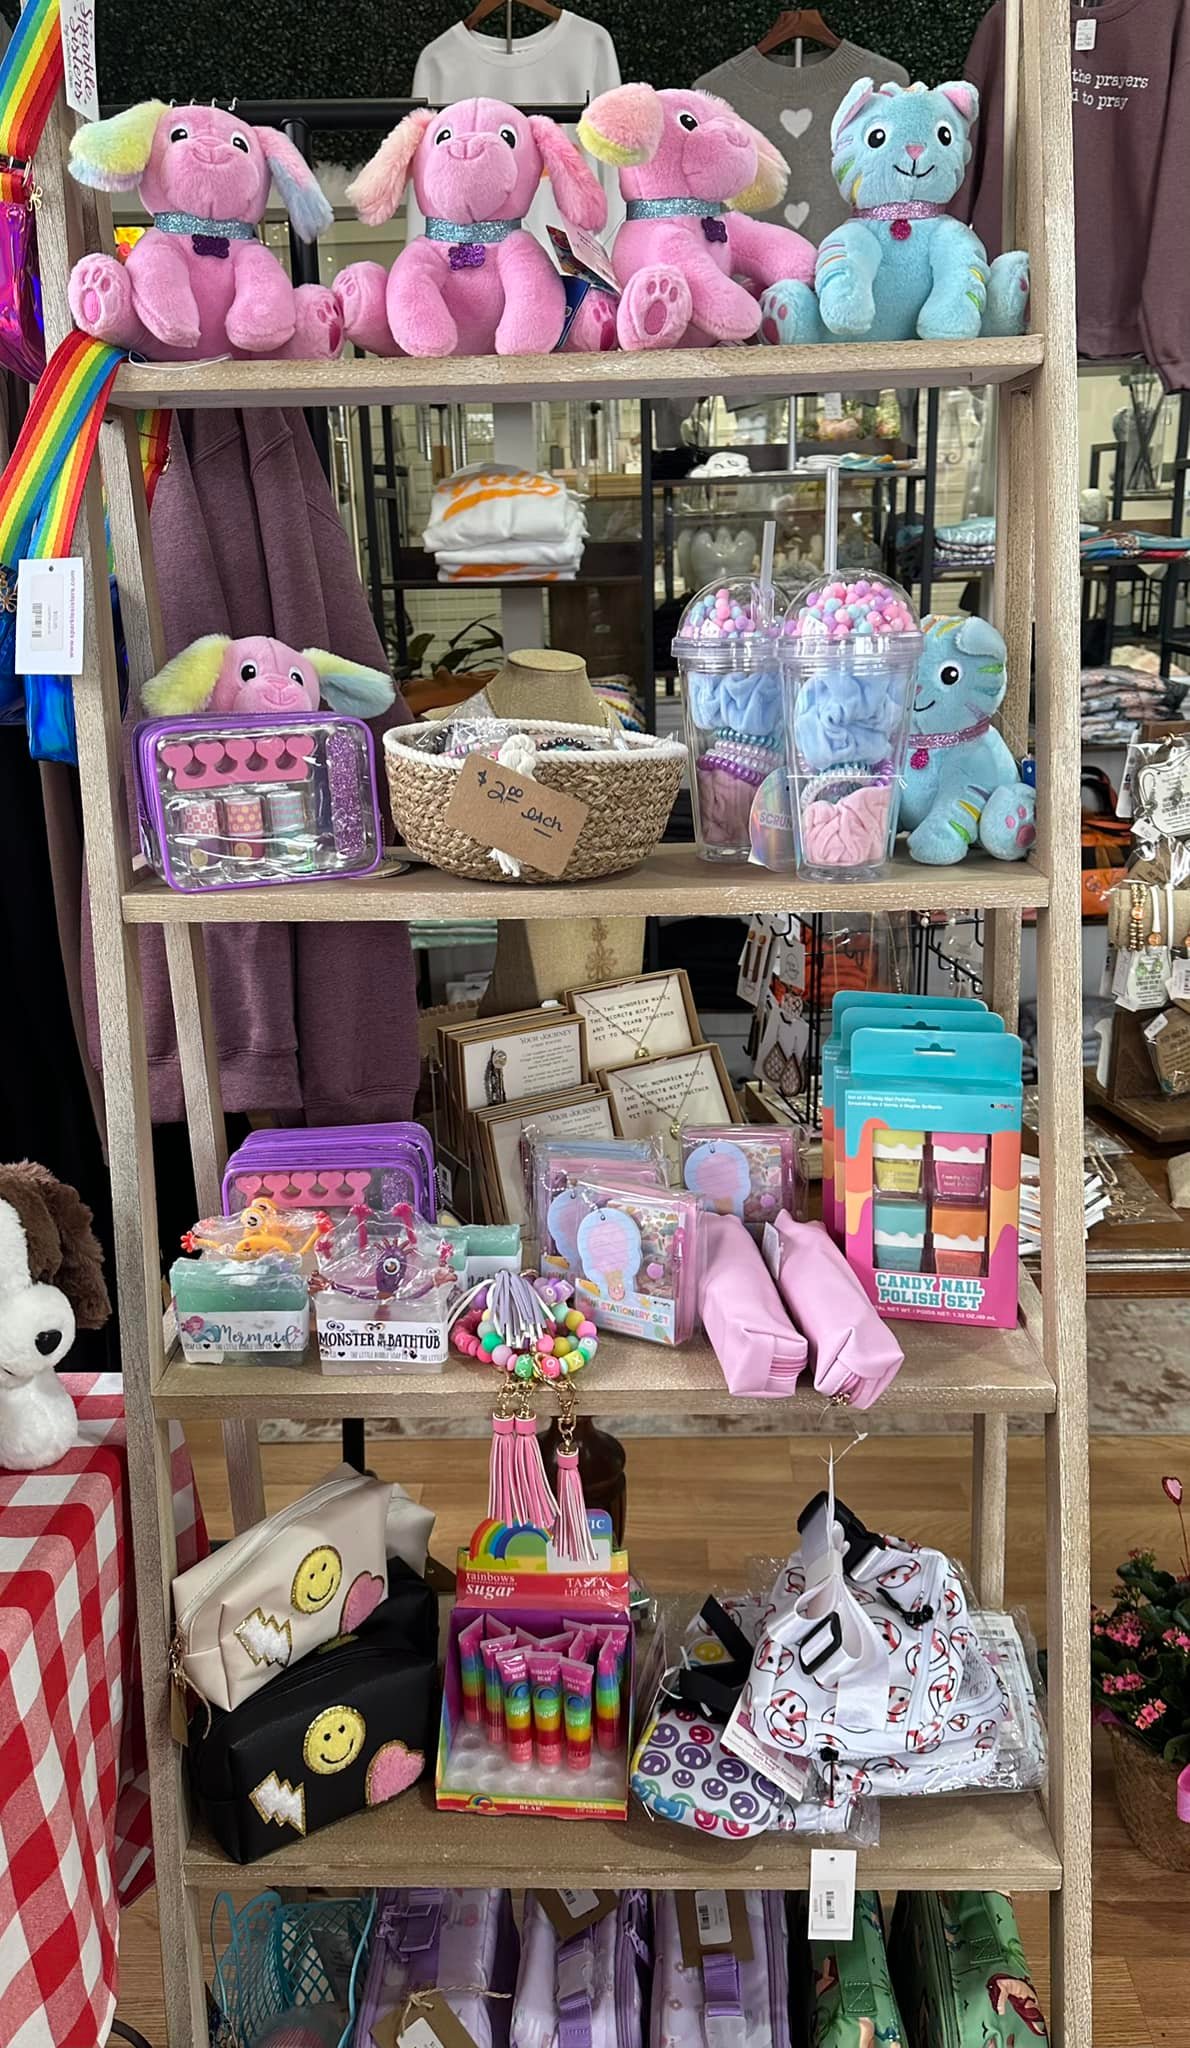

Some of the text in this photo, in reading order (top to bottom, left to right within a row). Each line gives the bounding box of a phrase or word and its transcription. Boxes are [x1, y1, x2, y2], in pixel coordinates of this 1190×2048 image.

[81, 1, 95, 101] Sparkle
[1072, 68, 1149, 89] the prayers
[1082, 91, 1094, 106] to
[1096, 95, 1129, 110] pray
[877, 1273, 984, 1295] CANDY NAIL
[880, 1289, 982, 1310] POLISH SET
[219, 1324, 299, 1345] Mermaid
[319, 1332, 375, 1347] MONSTER
[388, 1333, 441, 1349] BATHTUB
[466, 1572, 515, 1582] rainbows
[566, 1576, 608, 1588] TASTY
[466, 1583, 515, 1600] sugar
[565, 1588, 578, 1597] LIP
